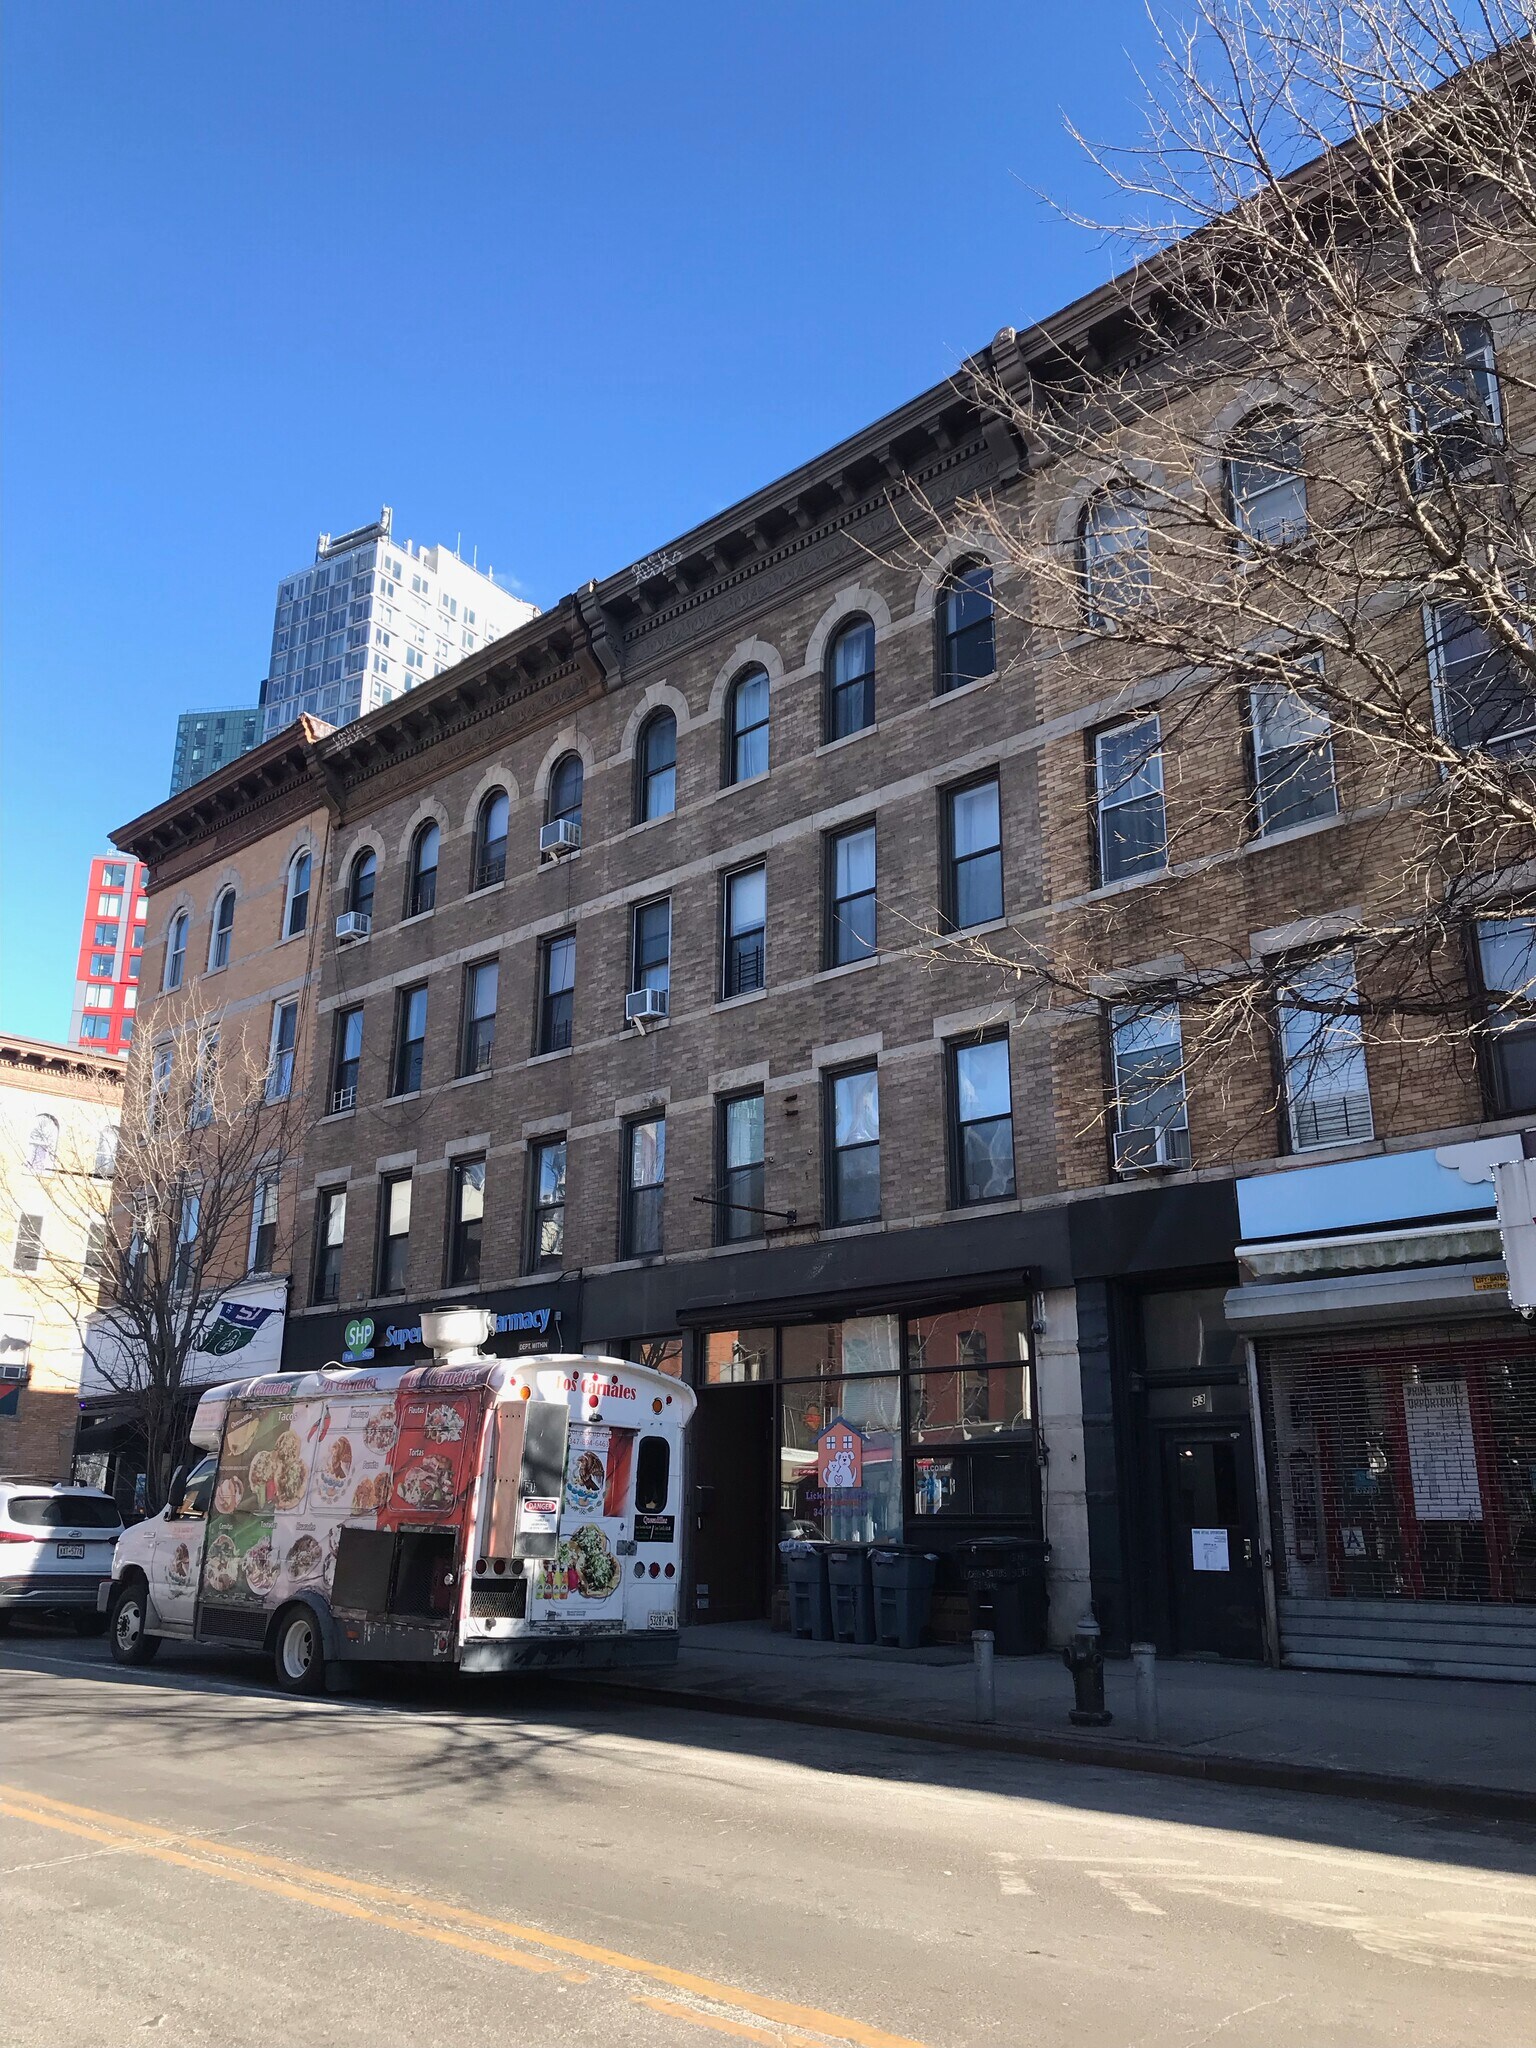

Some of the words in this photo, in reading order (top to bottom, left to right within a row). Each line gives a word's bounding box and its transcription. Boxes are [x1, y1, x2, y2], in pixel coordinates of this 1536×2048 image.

[495, 1308, 551, 1333] armacy
[348, 1324, 372, 1346] SHP
[581, 1379, 637, 1400] Carnales
[1193, 1394, 1205, 1406] 53
[278, 1411, 298, 1421] Tacos
[408, 1448, 425, 1457] Tortas
[528, 1502, 553, 1511] DANGER
[1347, 1530, 1361, 1549] A
